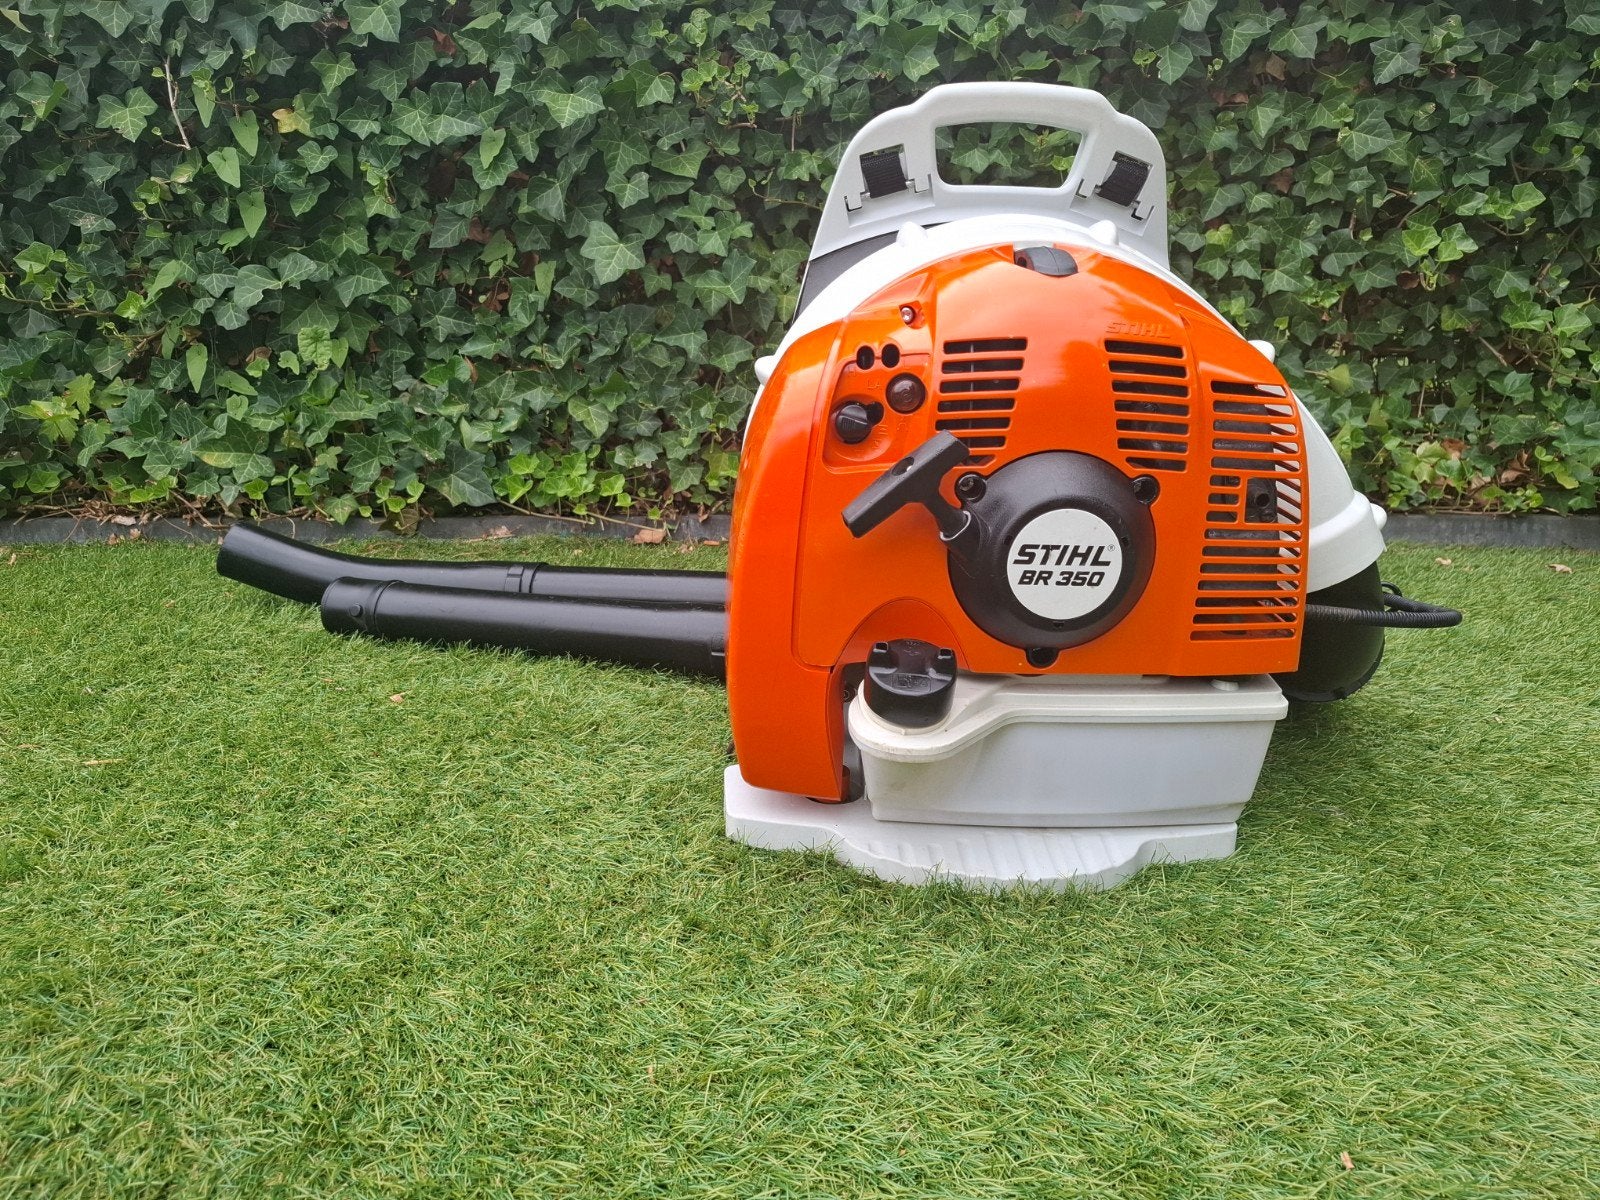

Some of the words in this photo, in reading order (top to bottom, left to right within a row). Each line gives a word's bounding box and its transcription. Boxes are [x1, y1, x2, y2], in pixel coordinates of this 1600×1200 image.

[1105, 321, 1170, 339] STIHL
[1012, 544, 1112, 567] STIHL
[1018, 570, 1053, 586] BR
[1055, 571, 1105, 587] 350
